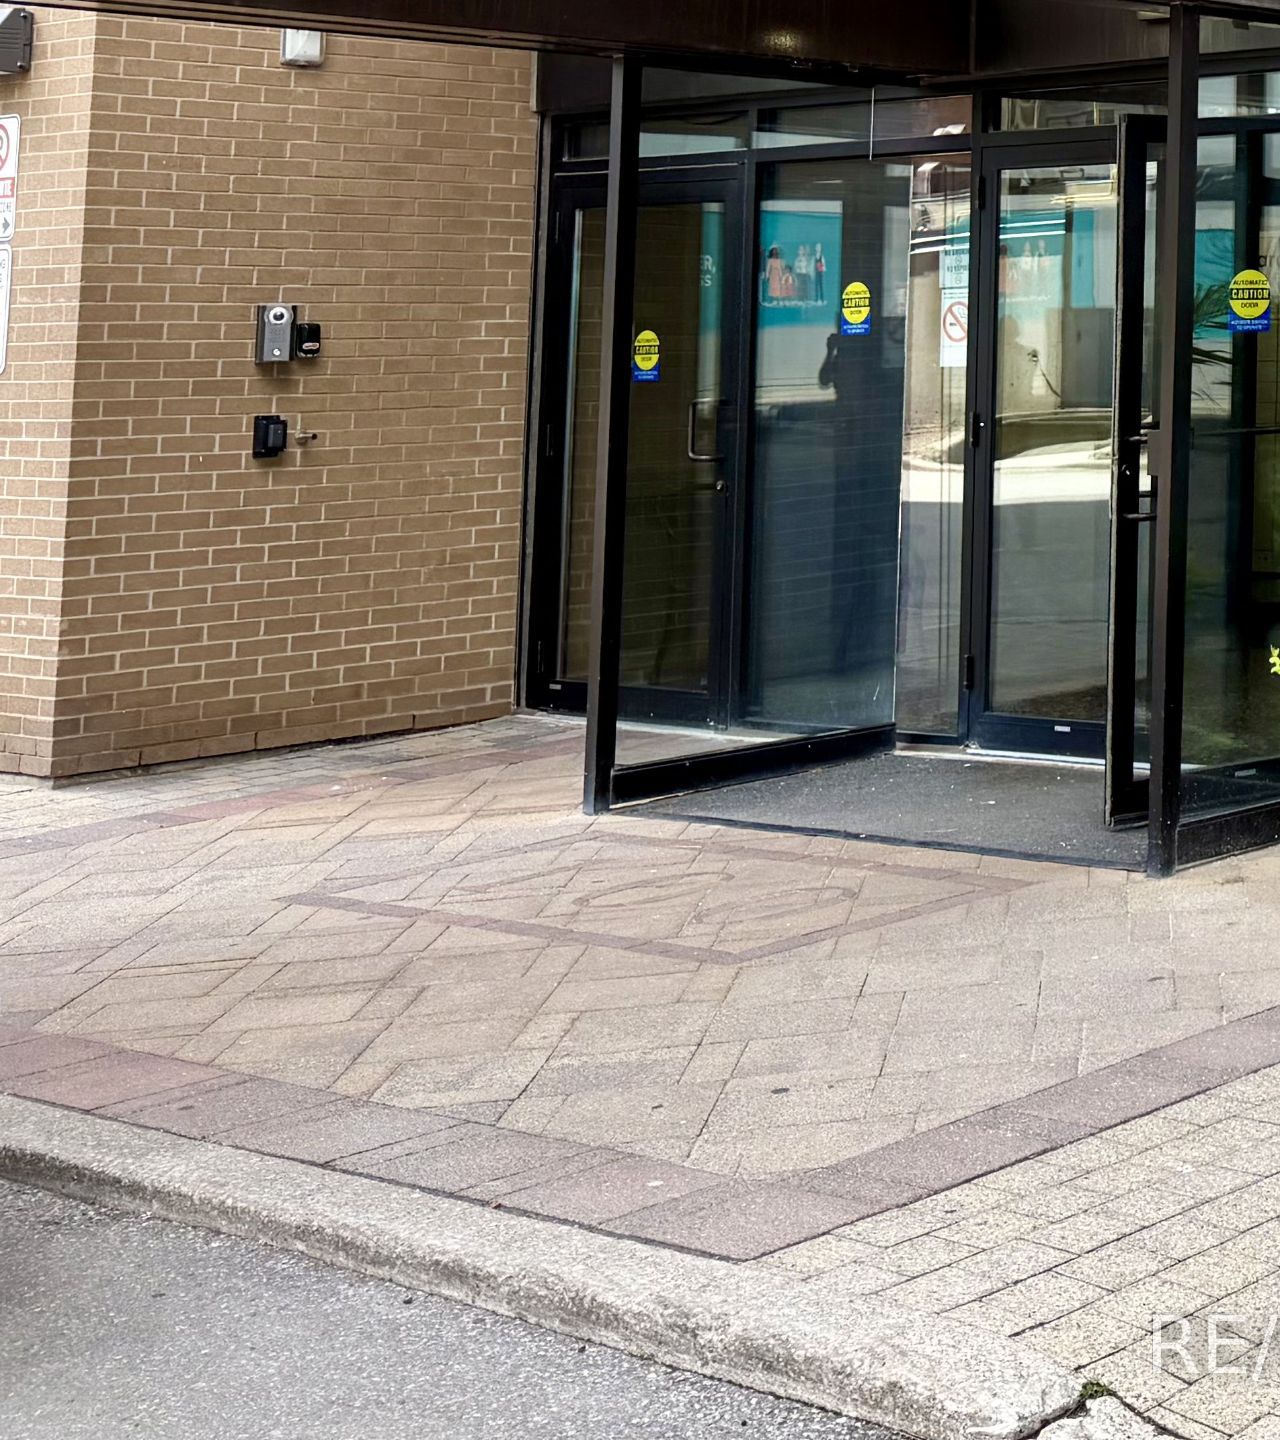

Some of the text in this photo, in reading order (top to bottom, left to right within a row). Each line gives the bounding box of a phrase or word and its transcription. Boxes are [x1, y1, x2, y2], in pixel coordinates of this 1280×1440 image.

[1232, 289, 1269, 299] CAUTION
[844, 298, 869, 307] CAUTION
[635, 346, 659, 354] CAUTION
